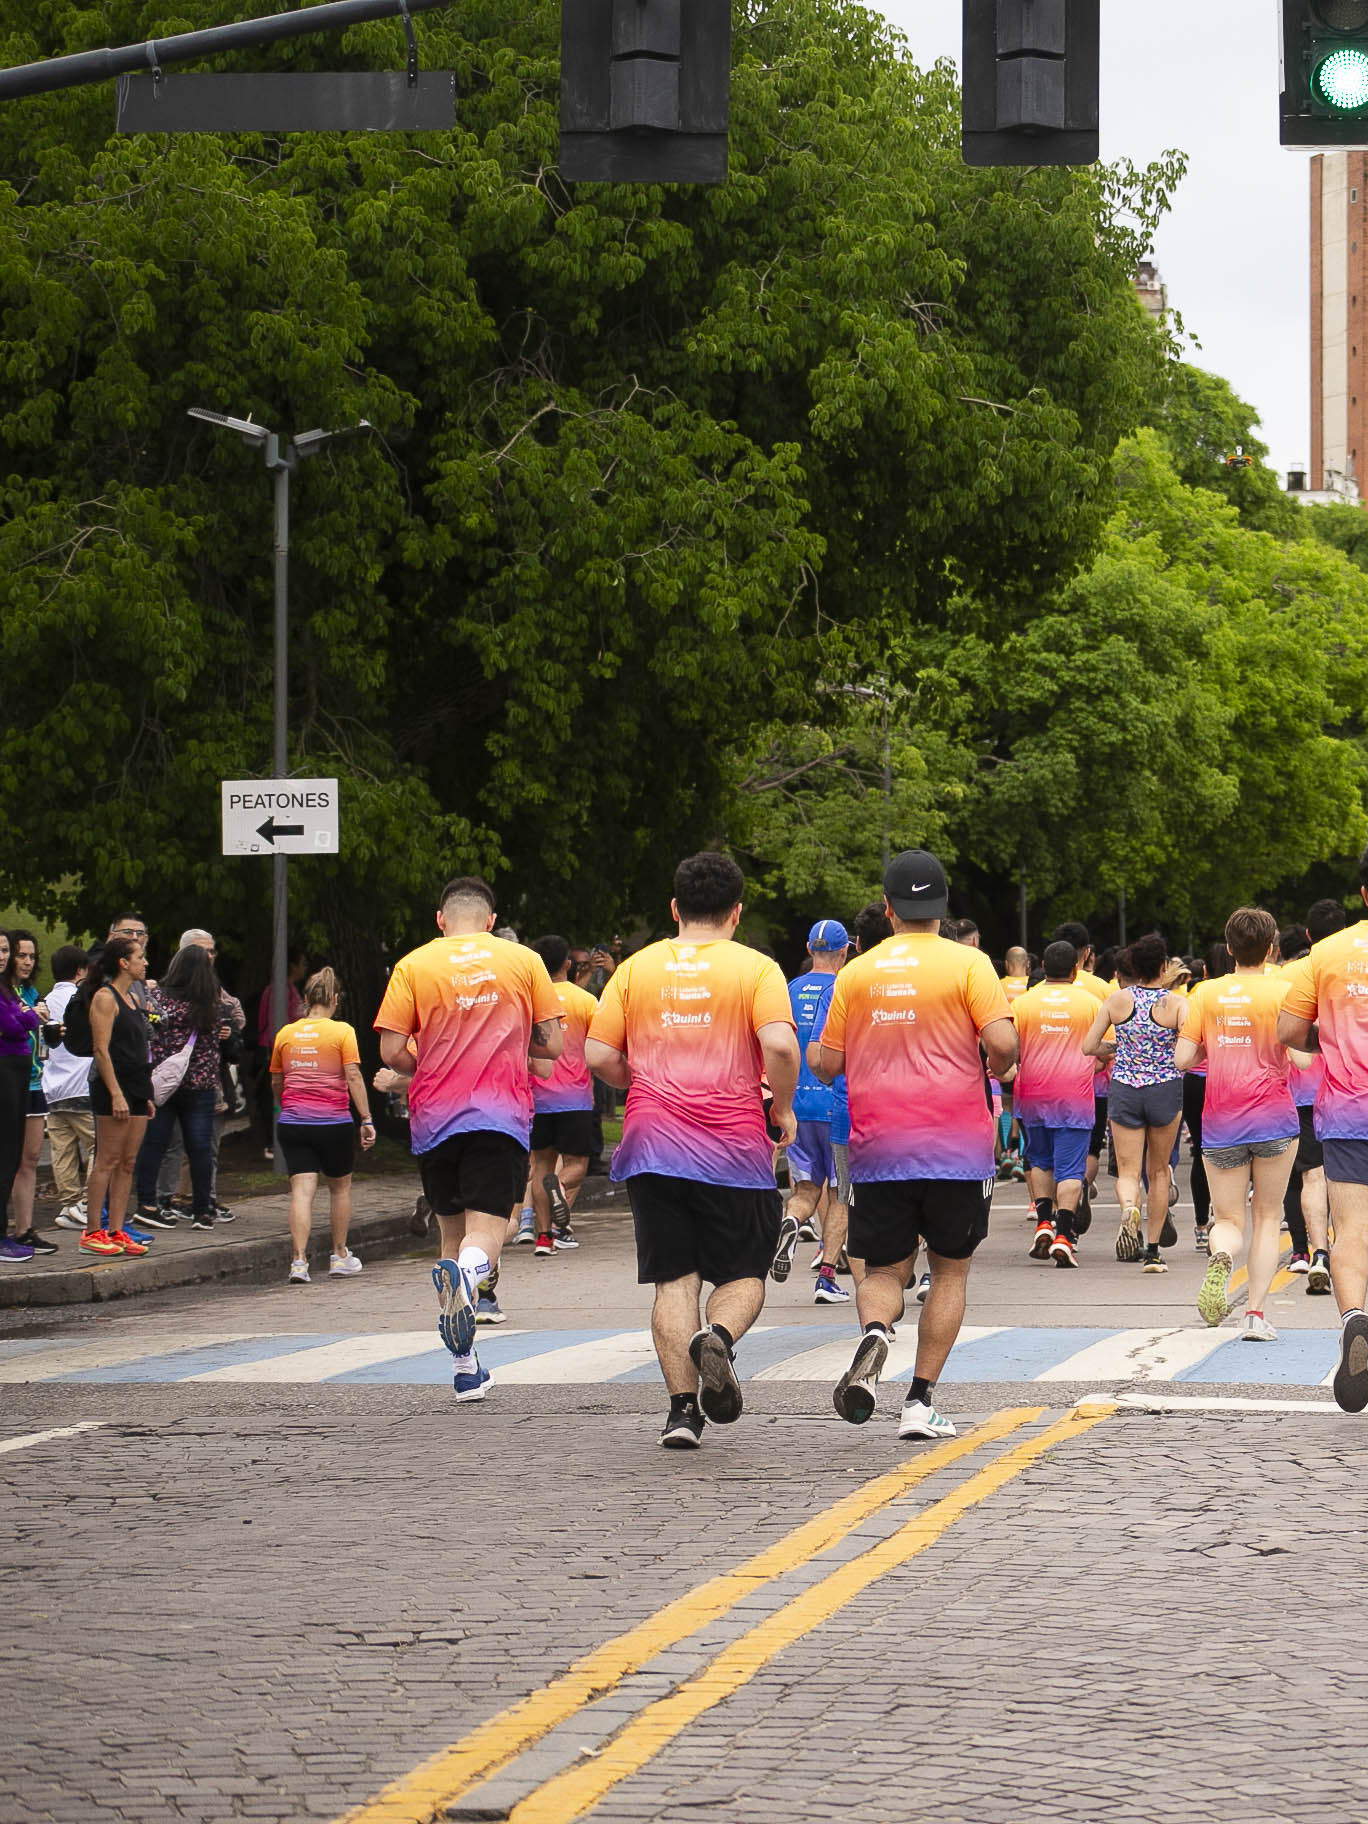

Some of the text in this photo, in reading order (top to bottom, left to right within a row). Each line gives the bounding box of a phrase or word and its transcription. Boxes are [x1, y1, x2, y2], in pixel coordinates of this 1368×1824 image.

[230, 793, 330, 809] PEATONES
[703, 1012, 711, 1023] 6
[907, 1008, 916, 1021] 6
